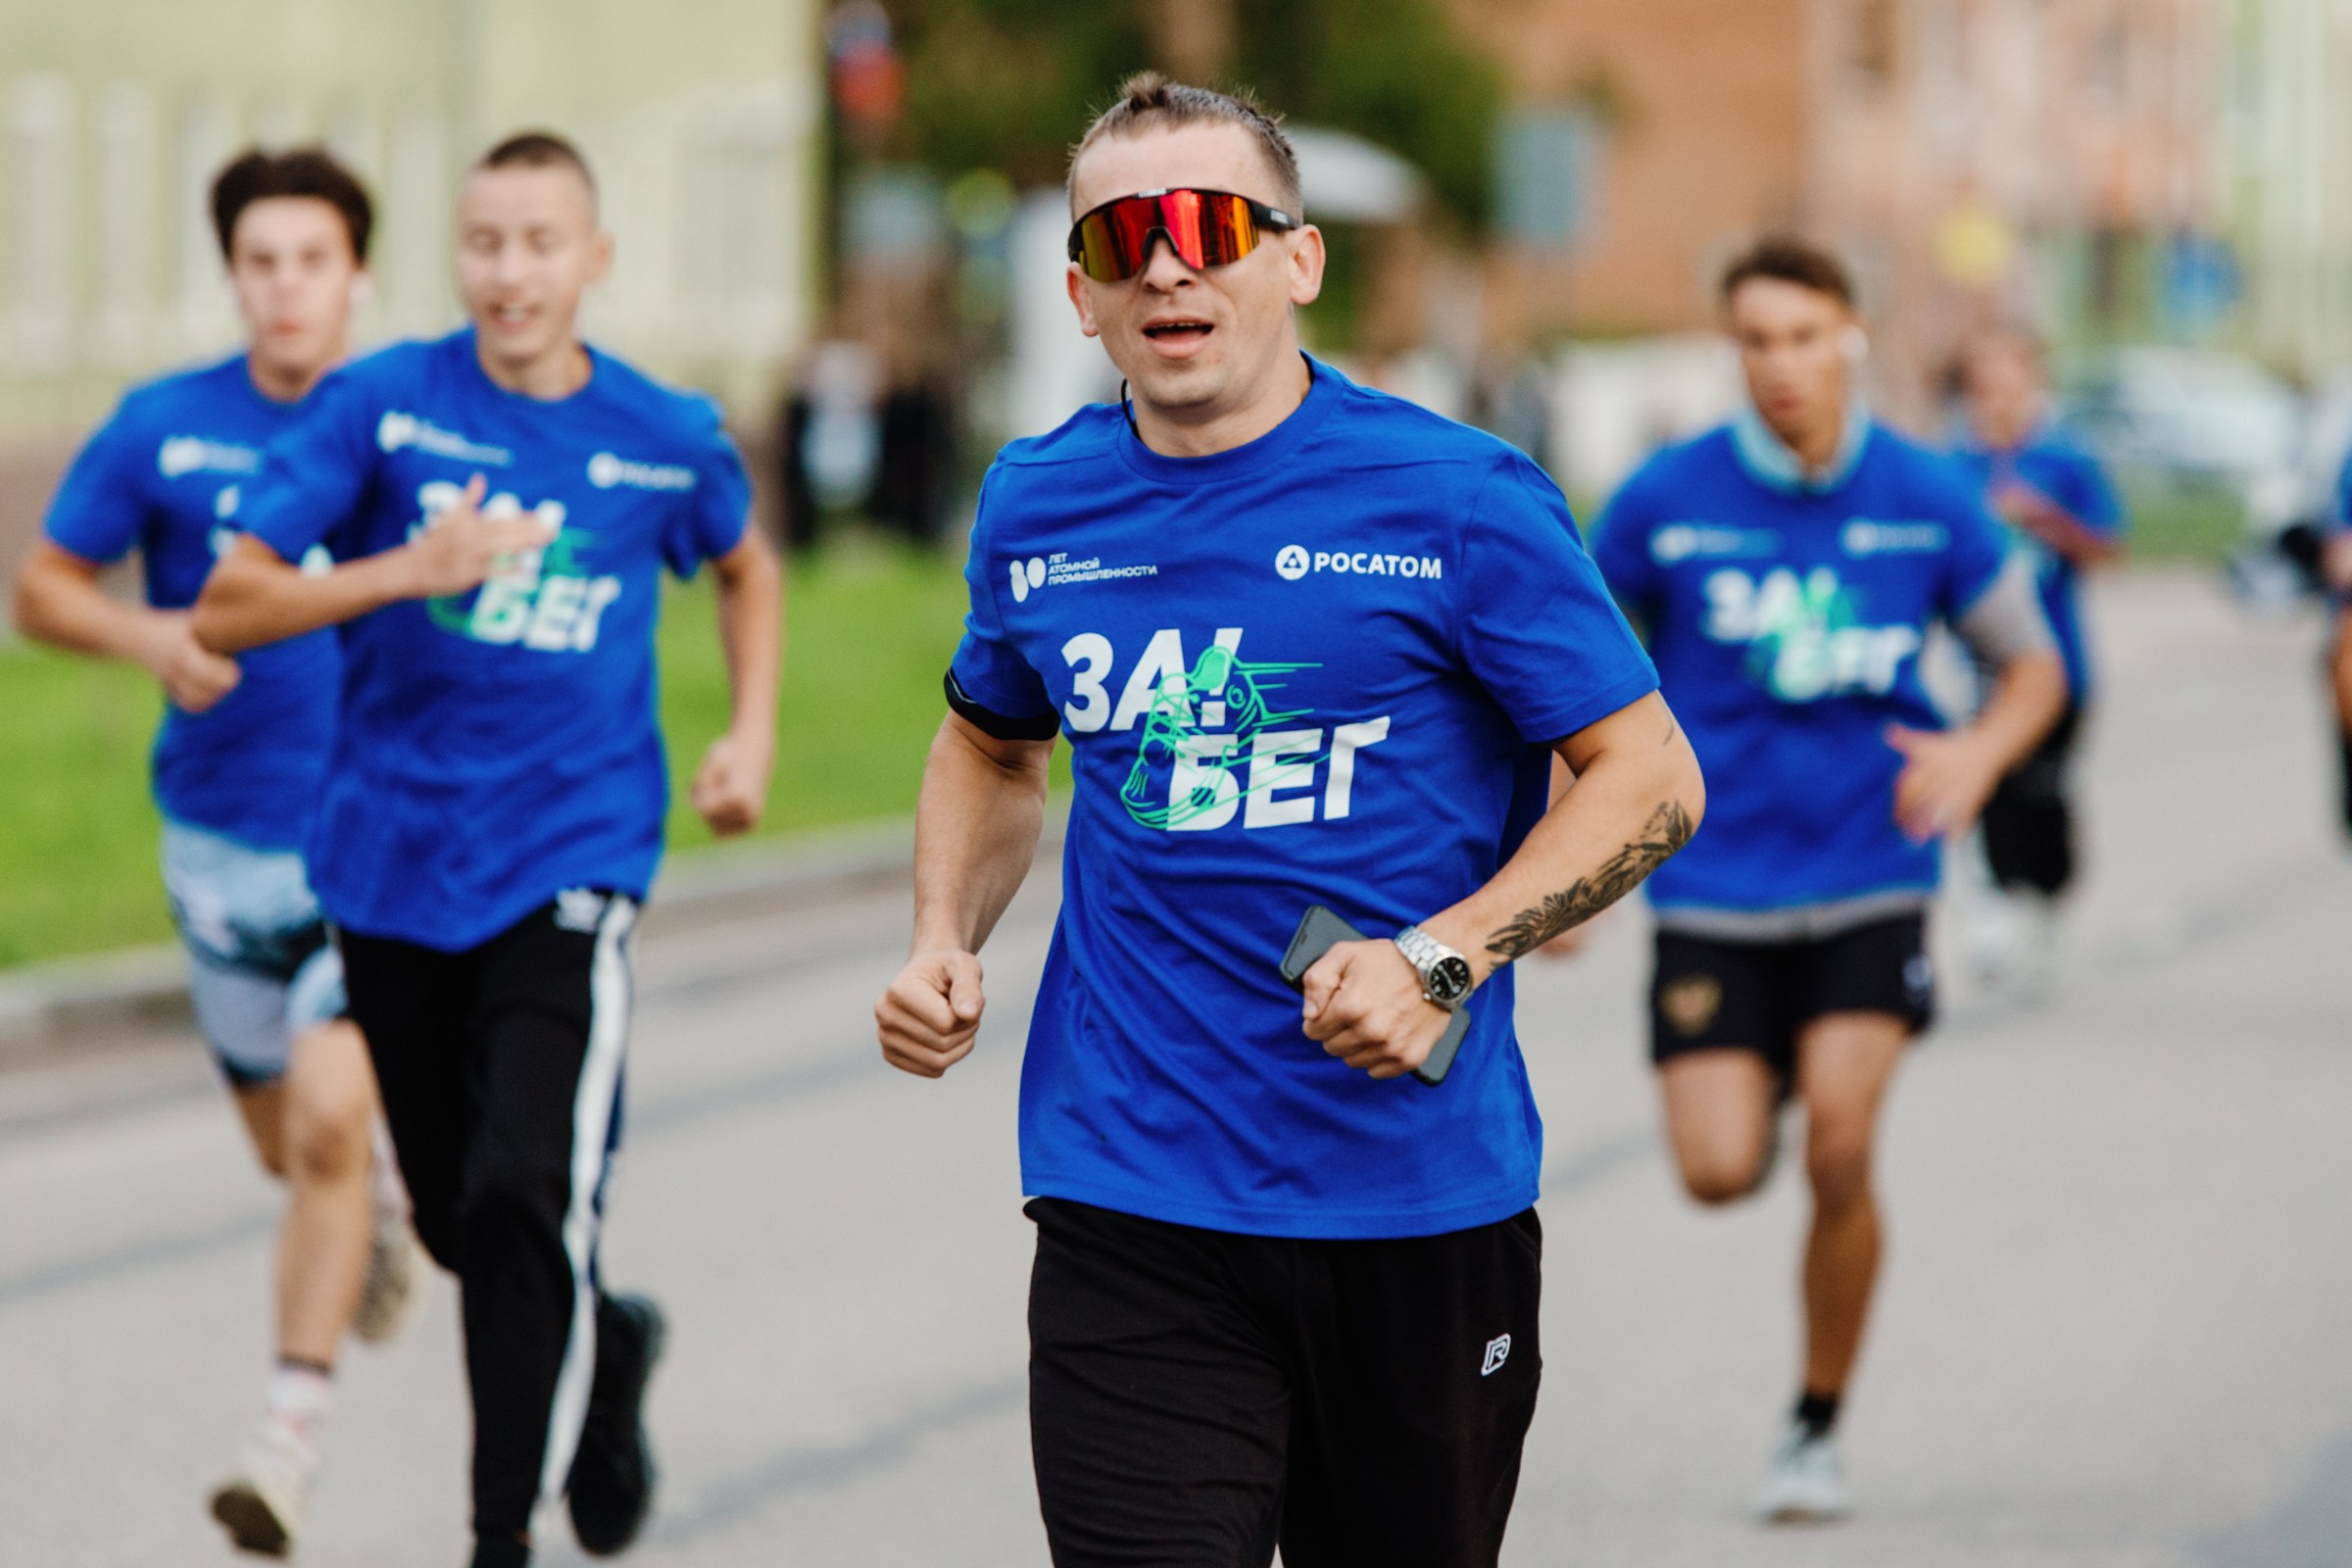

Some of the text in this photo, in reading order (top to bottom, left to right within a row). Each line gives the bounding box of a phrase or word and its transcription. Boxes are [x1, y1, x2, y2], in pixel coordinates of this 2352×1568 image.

[1048, 557, 1100, 575] АТОМНОЙ
[1049, 552, 1068, 564] ЛЕТ
[1314, 552, 1442, 579] РОСАТОМ
[1048, 564, 1157, 586] ПРОМЫШЛЕННОСТИ
[1166, 715, 1392, 831] БЕГ
